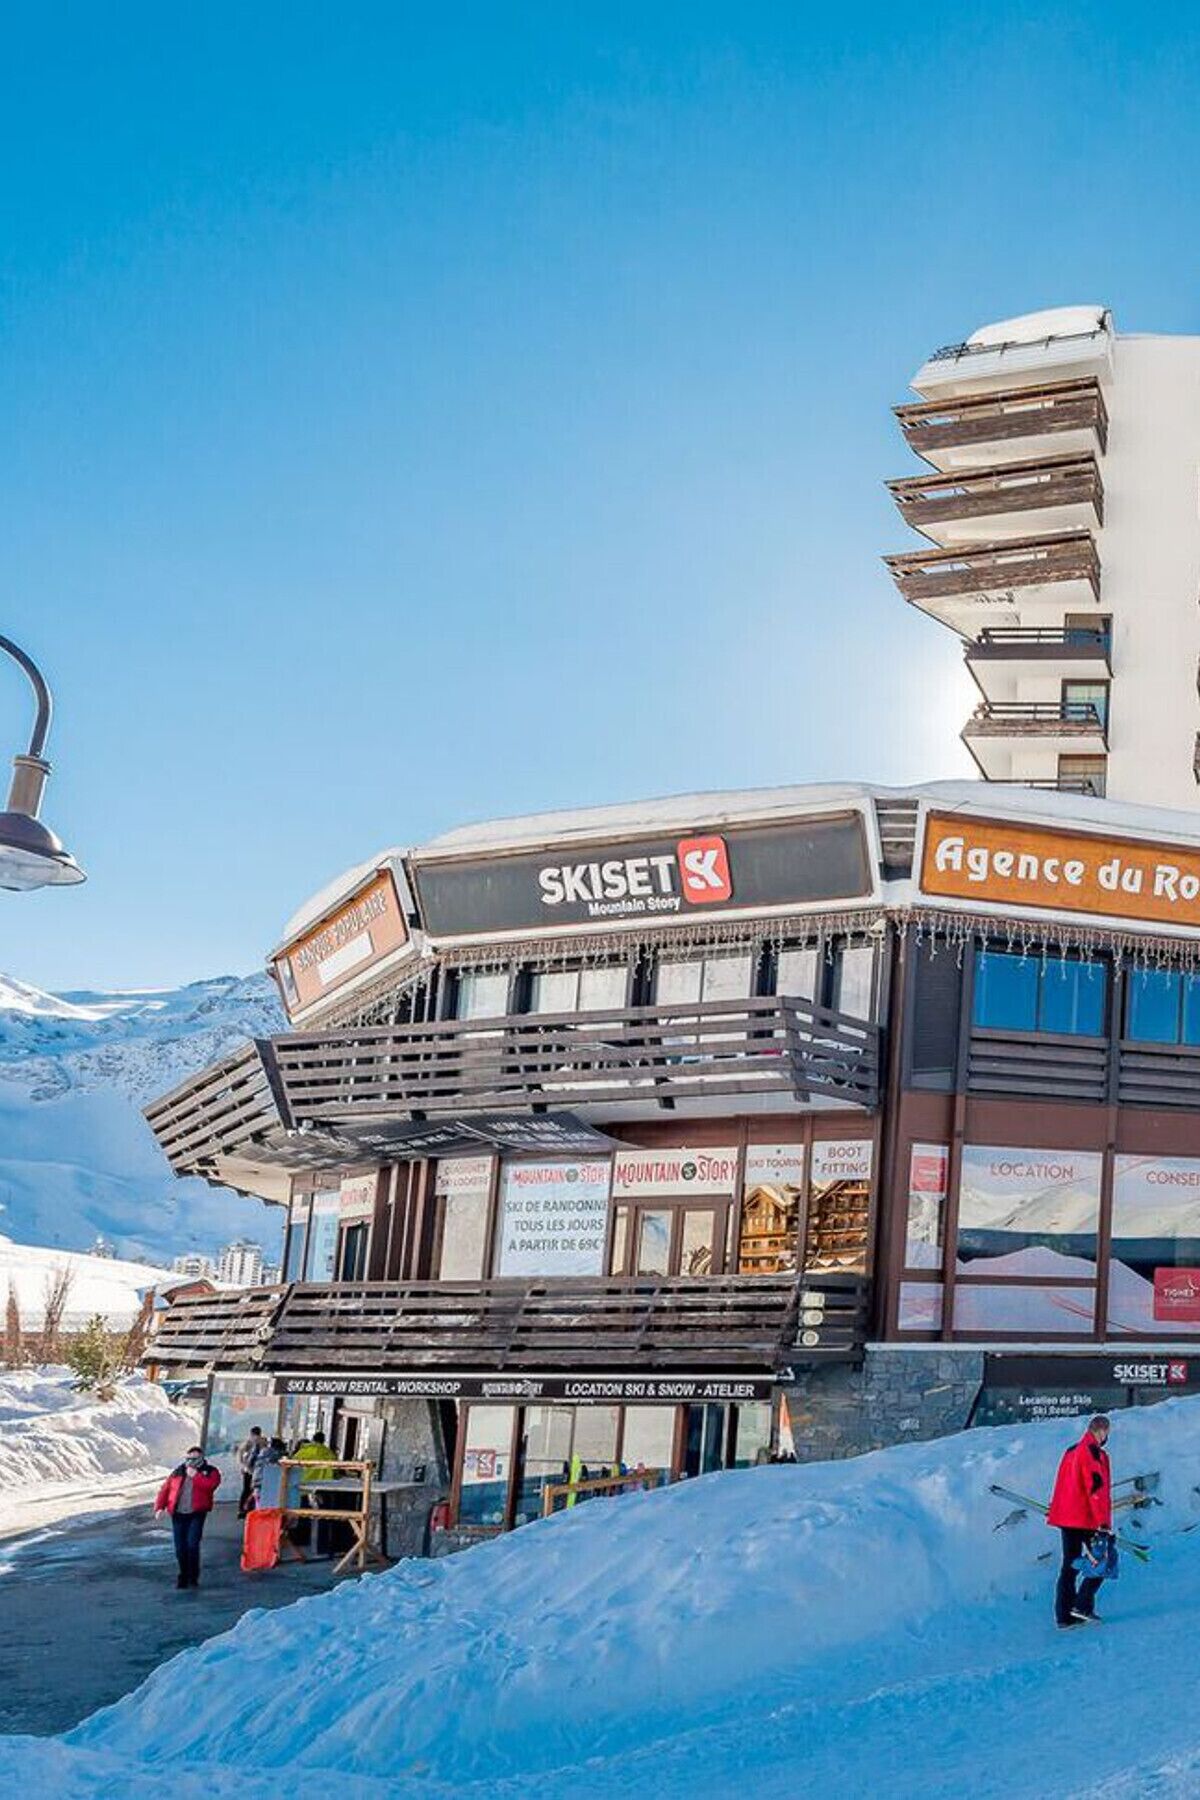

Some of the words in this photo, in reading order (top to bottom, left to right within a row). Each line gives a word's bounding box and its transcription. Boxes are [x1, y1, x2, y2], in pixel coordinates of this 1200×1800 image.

[934, 836, 1084, 885] Agence
[1098, 859, 1141, 894] du
[538, 854, 677, 905] SKISET
[588, 898, 646, 916] Mountain
[647, 896, 682, 912] Story
[827, 1146, 861, 1159] BOOT
[616, 1162, 680, 1188] MOUNTAIN
[697, 1154, 738, 1181] STORY
[821, 1161, 869, 1174] FITTING
[990, 1162, 1074, 1179] LOCATION
[513, 1168, 565, 1188] MOUNTAIN
[580, 1164, 607, 1184] STOR
[506, 1200, 523, 1213] SKI
[525, 1200, 541, 1213] DE
[542, 1200, 607, 1213] RANDONN
[514, 1219, 544, 1232] TOUS
[546, 1219, 565, 1231] LES
[566, 1219, 604, 1231] JOURS
[518, 1239, 559, 1251] PARTIR
[561, 1239, 577, 1251] DE
[1163, 1288, 1195, 1298] TIGNES
[1113, 1364, 1168, 1379] SKISET
[287, 1380, 305, 1392] SKI
[305, 1380, 314, 1391] &
[315, 1380, 347, 1392] SNOW
[348, 1381, 389, 1393] RENTAL
[397, 1381, 461, 1394] WORKSHOP
[565, 1383, 623, 1396] LOCATION
[624, 1383, 646, 1396] SKI
[646, 1384, 656, 1396] &
[657, 1384, 695, 1396] SNOW
[703, 1384, 755, 1397] ATELIER
[1019, 1395, 1059, 1405] Location
[1060, 1395, 1071, 1405] de
[1031, 1406, 1047, 1415] Ski
